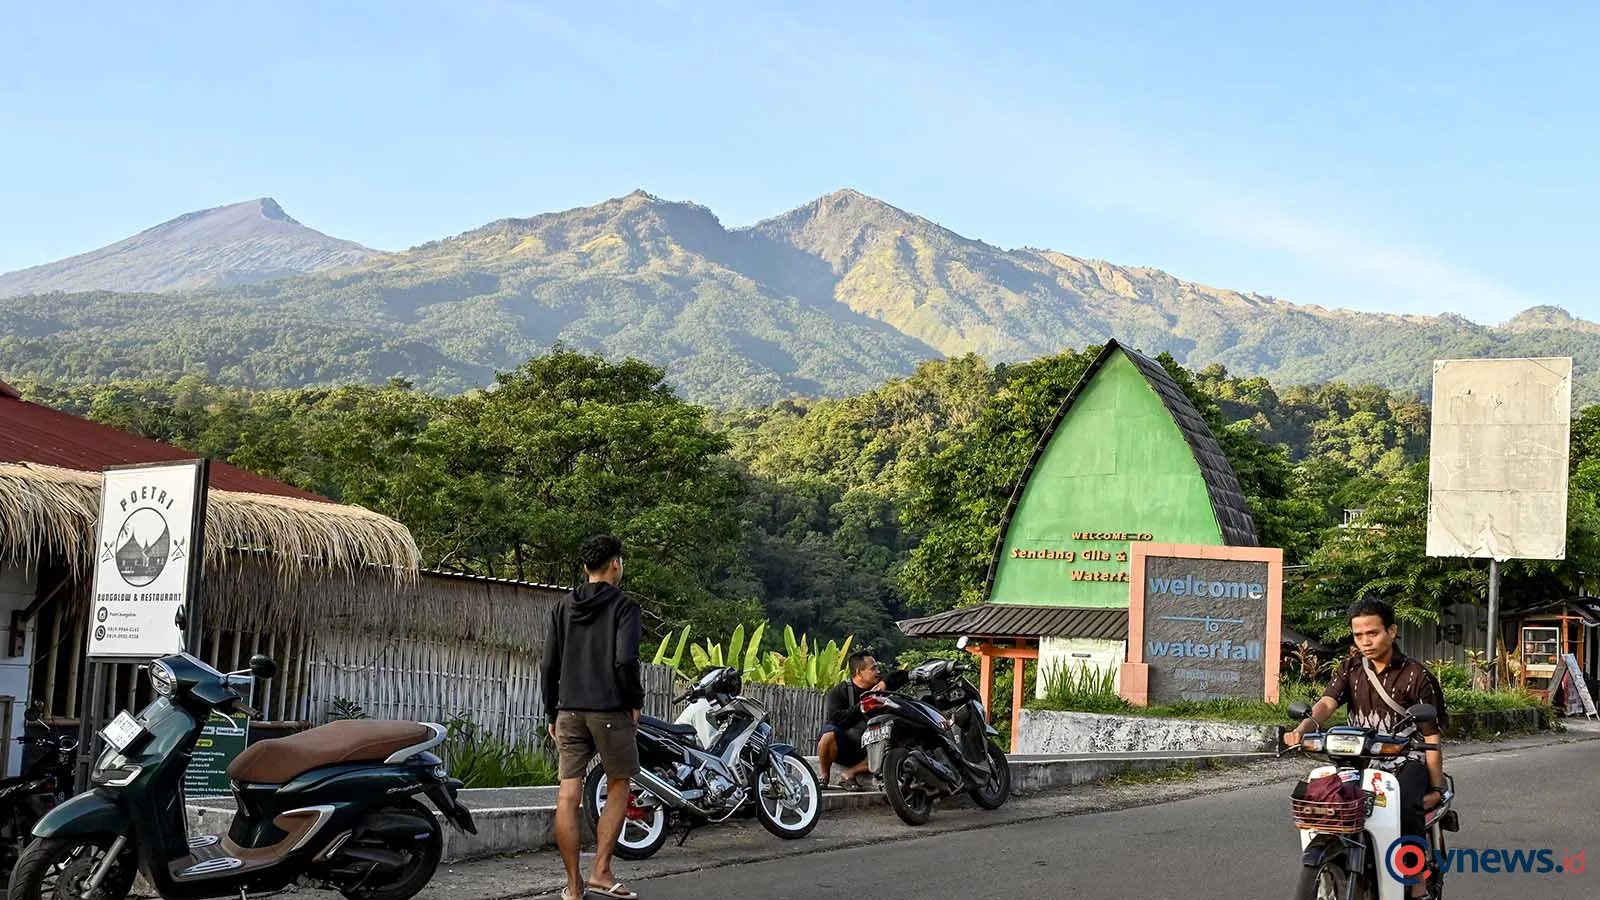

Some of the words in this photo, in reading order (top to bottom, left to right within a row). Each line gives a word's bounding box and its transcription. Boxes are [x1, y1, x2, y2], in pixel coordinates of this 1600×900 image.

[120, 486, 174, 512] POETRI
[1072, 532, 1128, 540] WELCOME
[1136, 533, 1153, 541] TO
[1010, 548, 1075, 563] Sendang
[1081, 549, 1111, 561] Gile
[1115, 551, 1128, 562] &
[1149, 575, 1264, 599] welcome
[97, 593, 131, 602] BUNGALOW
[133, 593, 138, 602] &
[140, 593, 181, 602] RESTAURANT
[1205, 615, 1219, 632] to
[1149, 640, 1260, 661] waterfall
